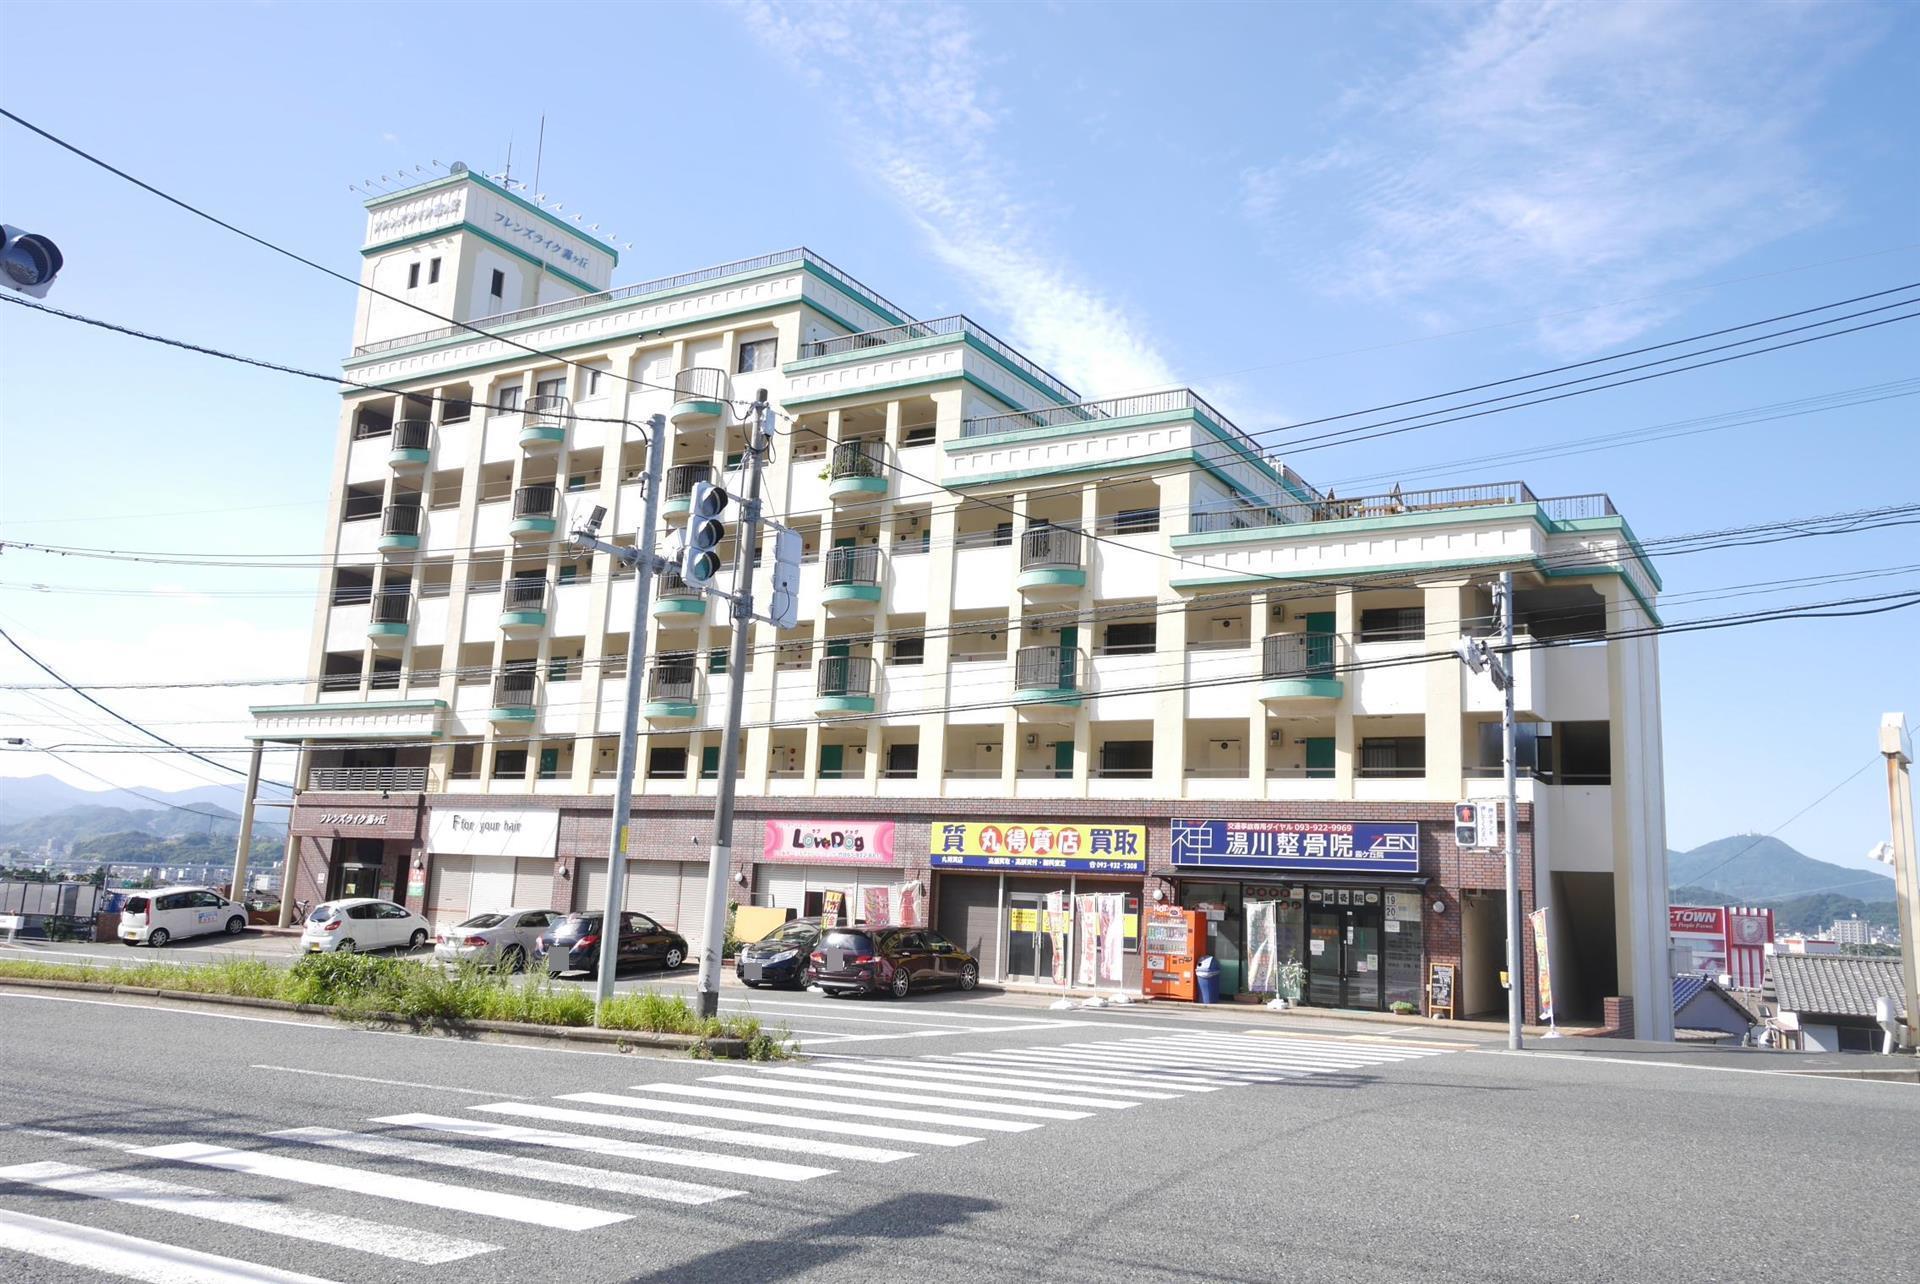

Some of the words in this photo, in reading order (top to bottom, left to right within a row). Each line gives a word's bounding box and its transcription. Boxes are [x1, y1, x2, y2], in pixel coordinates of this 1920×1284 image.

[480, 821, 500, 834] your
[504, 820, 522, 833] hair
[1294, 823, 1353, 832] 093-922-9969
[942, 824, 966, 852] 質
[981, 828, 1079, 854] 丸得質店
[1090, 828, 1137, 855] 買取
[1226, 831, 1353, 858] 湯川整骨院
[1369, 834, 1416, 850] ZEN
